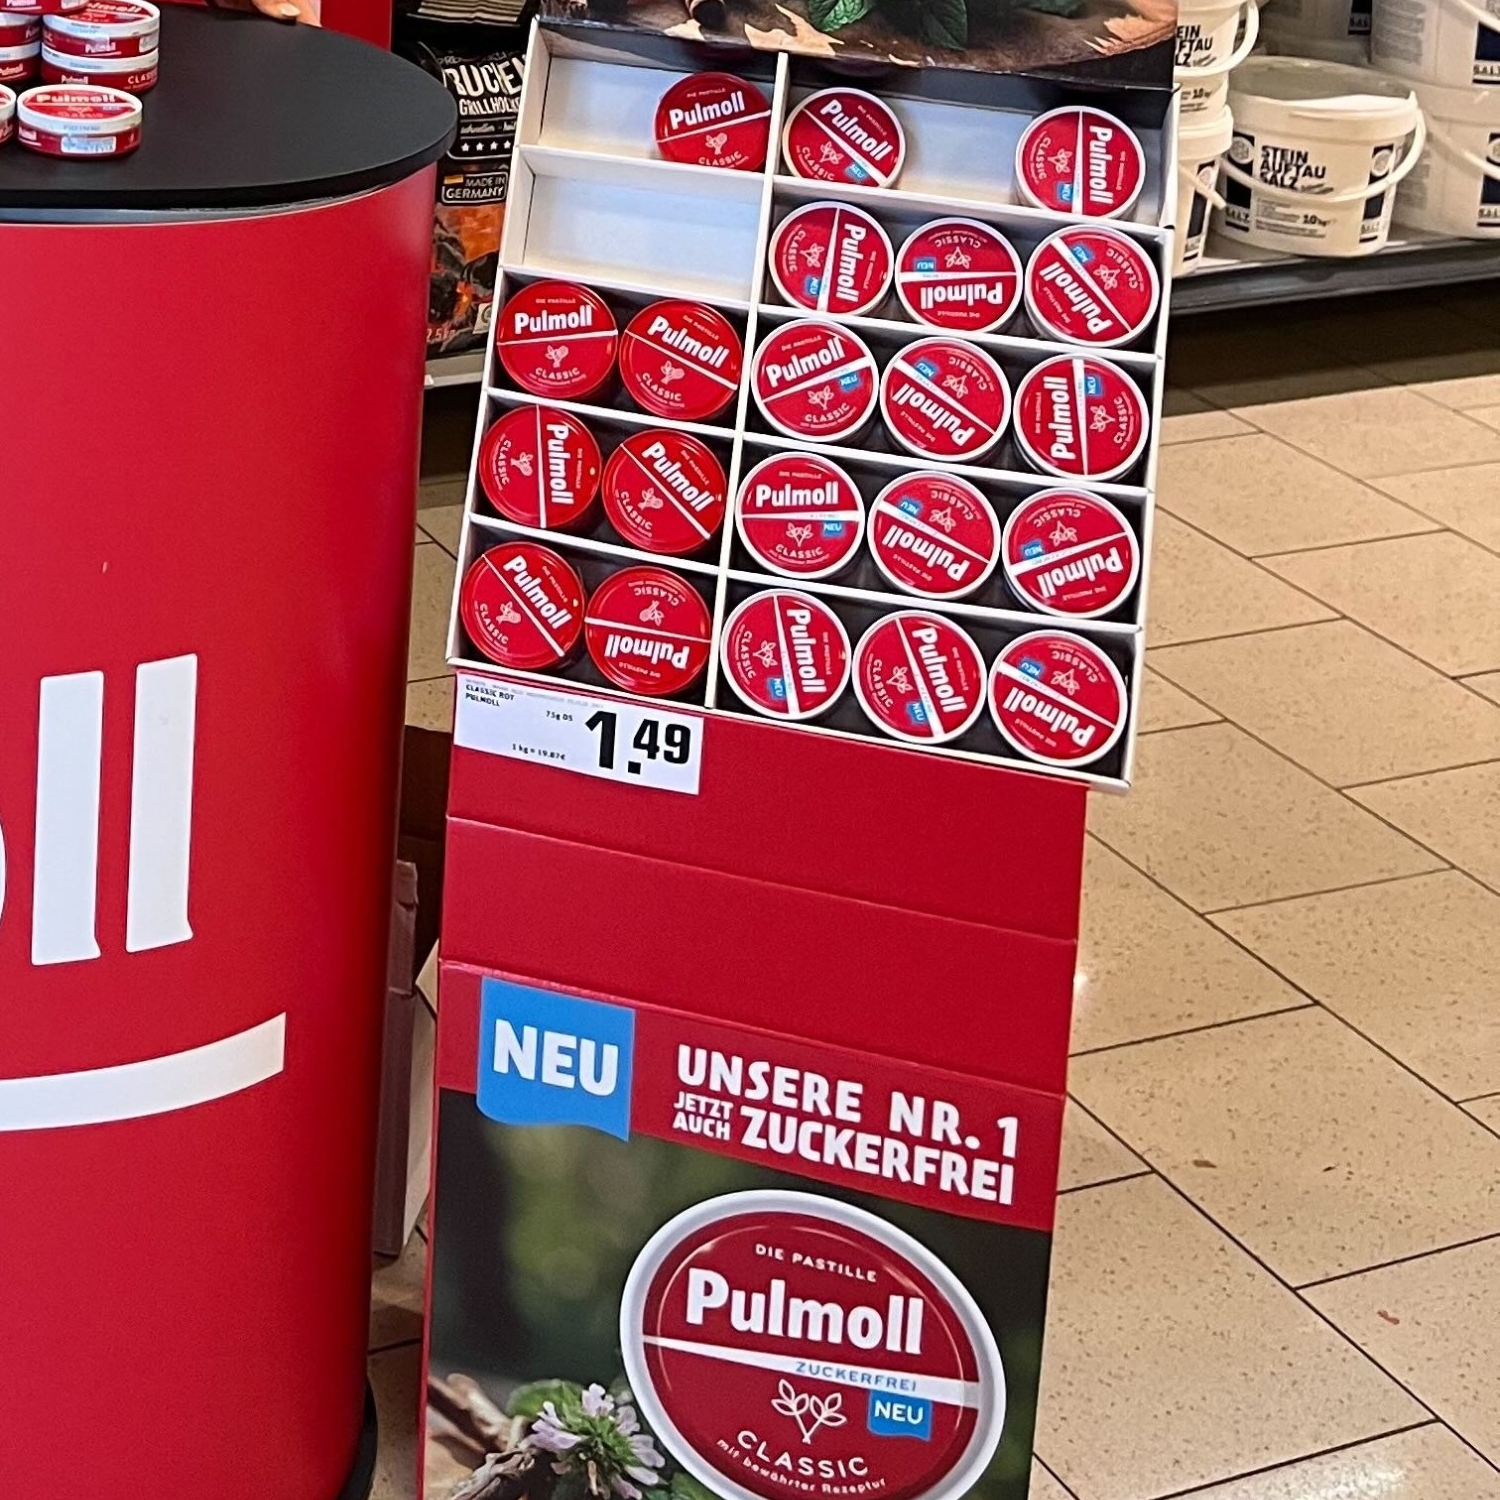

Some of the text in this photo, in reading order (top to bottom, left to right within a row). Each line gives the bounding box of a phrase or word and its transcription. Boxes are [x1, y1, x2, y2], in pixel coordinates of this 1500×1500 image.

[669, 91, 745, 130] Pulmoll
[820, 99, 894, 162] Pulmoll
[1089, 125, 1114, 206] Pulmoll
[1260, 160, 1327, 179] AUFTAU
[1261, 145, 1309, 164] STEIN
[445, 186, 504, 200] GERMANY
[465, 177, 494, 188] MADE
[1260, 172, 1299, 190] SALZ
[934, 233, 982, 249] CLASSIC
[835, 223, 867, 302] Pulmoll
[920, 281, 1003, 310] Pulmoll
[1041, 261, 1113, 337] Pulmoll
[515, 305, 593, 335] Pulmoll
[647, 315, 730, 370] Pulmoll
[765, 335, 847, 389] Pulmoll
[534, 366, 581, 381] CLASSIC
[642, 372, 682, 402] CLASSIC
[948, 356, 989, 391] CLASSIC
[1087, 376, 1097, 395] NEU
[804, 401, 851, 424] CLASSIC
[892, 381, 976, 448] Pulmoll
[1042, 376, 1076, 461] Pulmoll
[1113, 395, 1126, 445] CLASSIC
[501, 438, 512, 486] CLASSIC
[546, 423, 575, 506] Pulmoll
[641, 441, 715, 512] Pulmoll
[619, 490, 653, 531] CLASSIC
[755, 481, 840, 509] Pulmoll
[898, 499, 921, 515] NEU
[930, 488, 975, 522] CLASSIC
[823, 522, 842, 534] NEU
[1032, 508, 1083, 529] CLASSIC
[774, 543, 824, 559] CLASSIC
[882, 523, 972, 582] Pulmoll
[1036, 546, 1124, 600] Pulmoll
[503, 555, 572, 631] Pulmoll
[633, 586, 680, 607] CLASSIC
[478, 602, 510, 646] CLASSIC
[604, 634, 690, 670] Pulmoll
[744, 630, 757, 679] CLASSIC
[786, 609, 828, 695] Pulmoll
[911, 627, 968, 714] Pulmoll
[1050, 649, 1100, 683] CLASSIC
[465, 683, 498, 699] CLASSIC
[499, 691, 515, 701] ROT
[465, 692, 500, 707] PULMOLL
[872, 658, 896, 710] CLASSIC
[912, 701, 925, 721] NEU
[1003, 686, 1097, 749] Pulmoll
[585, 710, 691, 775] 1.49
[492, 1019, 619, 1096] NEU
[674, 1091, 733, 1120] JETZT
[676, 1045, 1018, 1159] UNSERE NR. 1
[672, 1112, 730, 1141] AUCH
[740, 1107, 1014, 1206] ZUCKERFREI
[755, 1244, 877, 1283] DIE PASTILLE
[686, 1268, 924, 1355] Pulmoll
[796, 1362, 917, 1392] ZUCKERFREI
[874, 1400, 924, 1424] NEU
[716, 1439, 887, 1495] mit bewährter Rezeptur
[737, 1430, 869, 1480] CLASSIC
